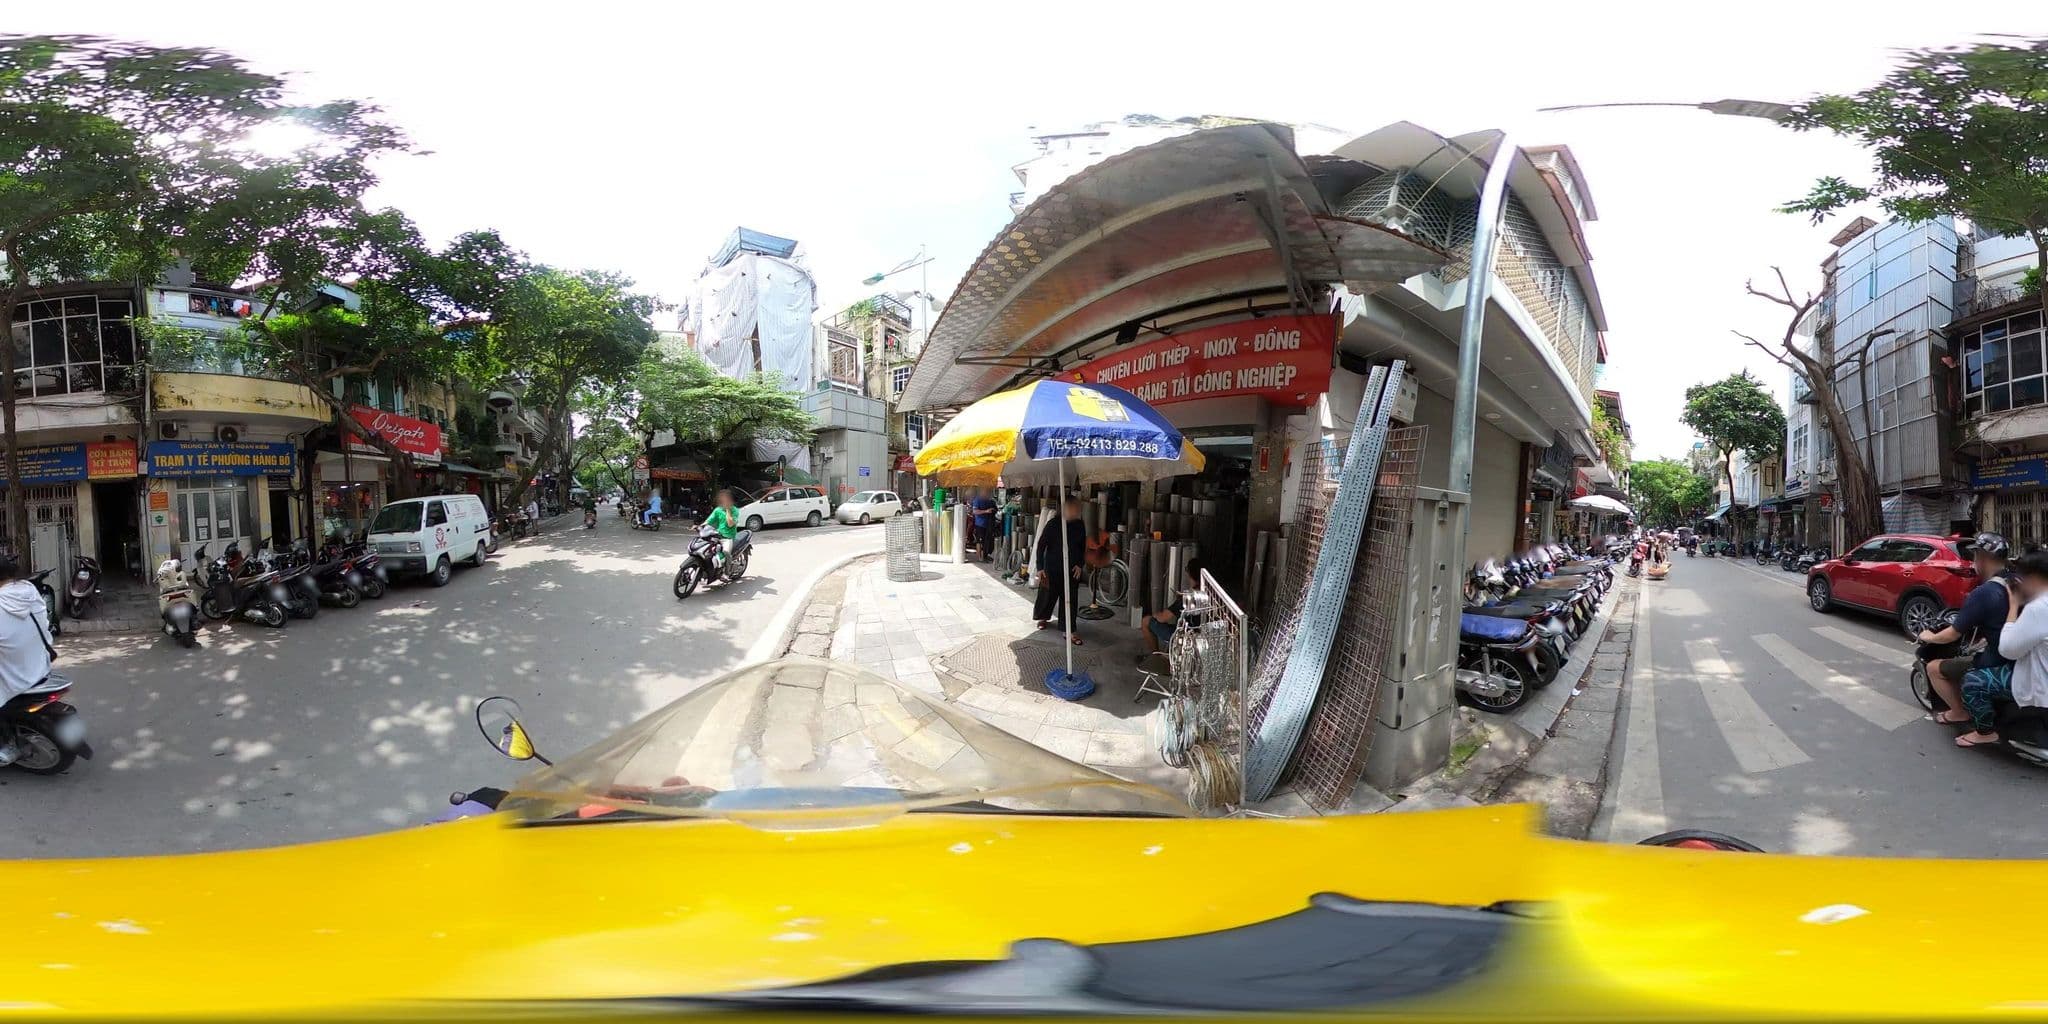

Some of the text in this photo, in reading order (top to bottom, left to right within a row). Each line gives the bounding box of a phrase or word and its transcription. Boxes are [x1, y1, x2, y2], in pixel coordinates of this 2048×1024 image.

[1096, 360, 1131, 384] CHUYÊN
[1132, 350, 1157, 375] LƯỚI
[1160, 344, 1190, 368] THÉP
[1203, 336, 1239, 359] INOX
[1254, 326, 1300, 352] ĐỒNG
[1137, 380, 1168, 402] BĂNG
[1171, 373, 1191, 398] TẢI
[1193, 369, 1232, 393] CÔNG
[1236, 362, 1297, 390] NGHIỆP
[371, 413, 425, 445] Origato
[154, 455, 184, 469] TRẠM
[187, 454, 193, 467] Y
[197, 451, 209, 466] TẾ
[211, 451, 250, 466] PHƯỜNG
[253, 451, 277, 466] HÀNG
